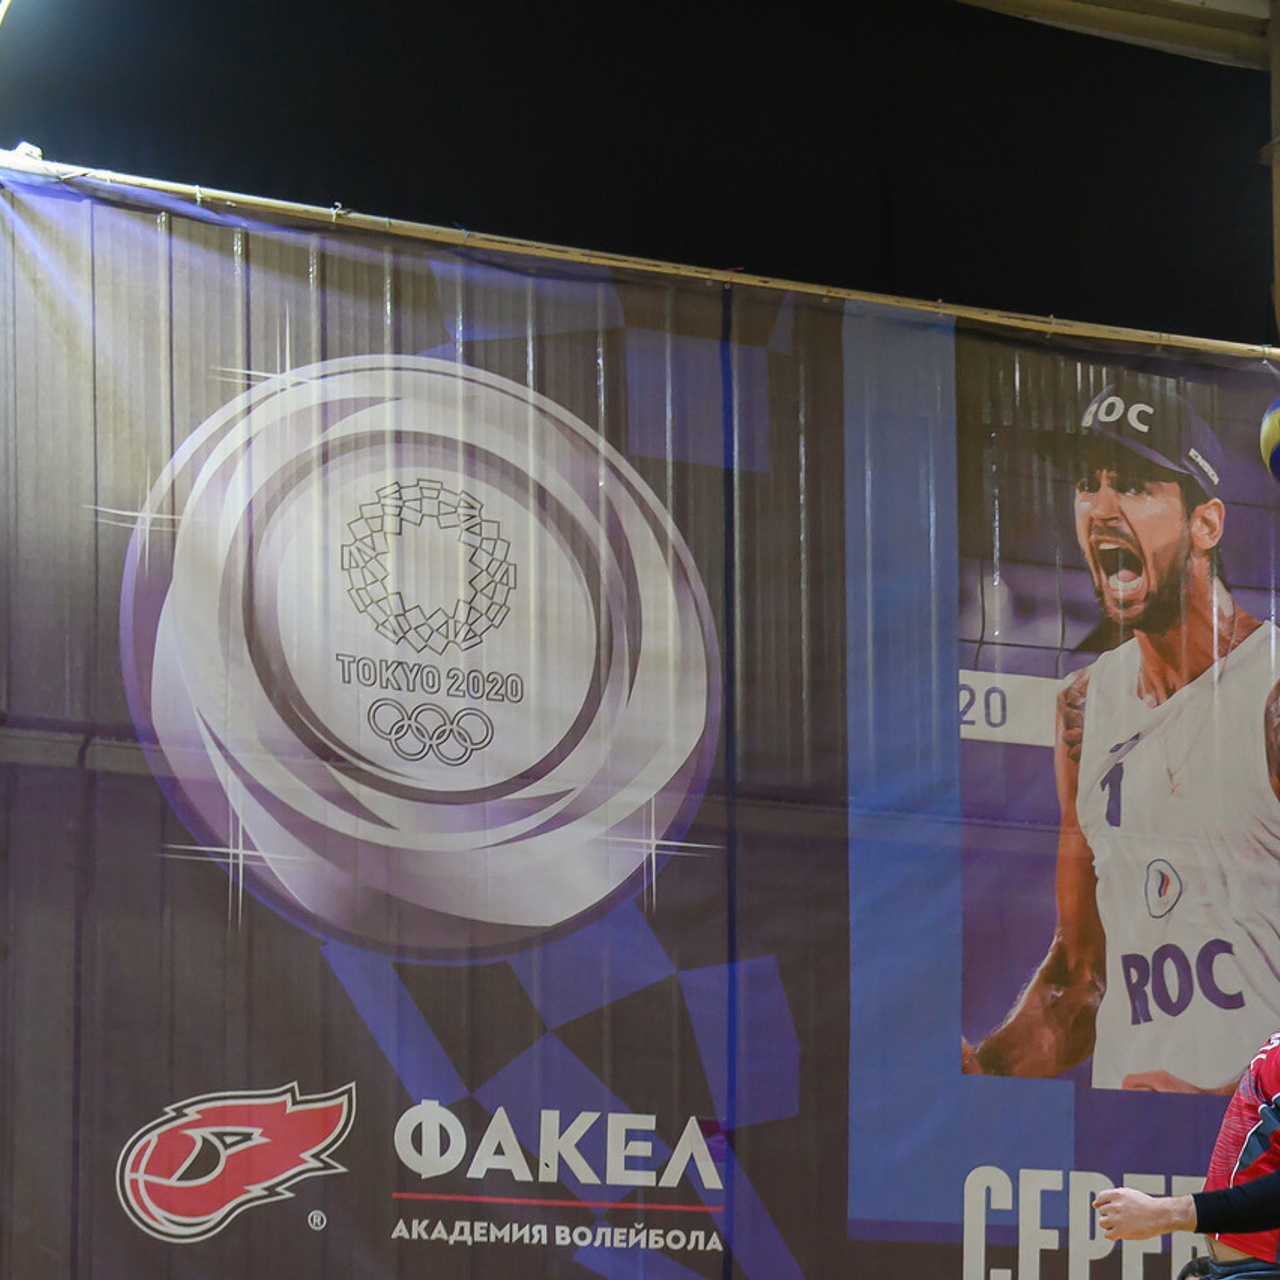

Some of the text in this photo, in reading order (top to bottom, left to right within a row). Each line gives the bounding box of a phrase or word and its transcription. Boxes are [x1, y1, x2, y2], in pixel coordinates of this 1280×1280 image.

[336, 653, 524, 703] TOKYO 2020
[1100, 761, 1124, 827] 1
[1121, 939, 1245, 1025] ROC
[394, 1099, 723, 1190] ФАКЕЛ
[391, 1218, 723, 1251] АКАДЕМИЯ ВОЛЕЙБОЛА
